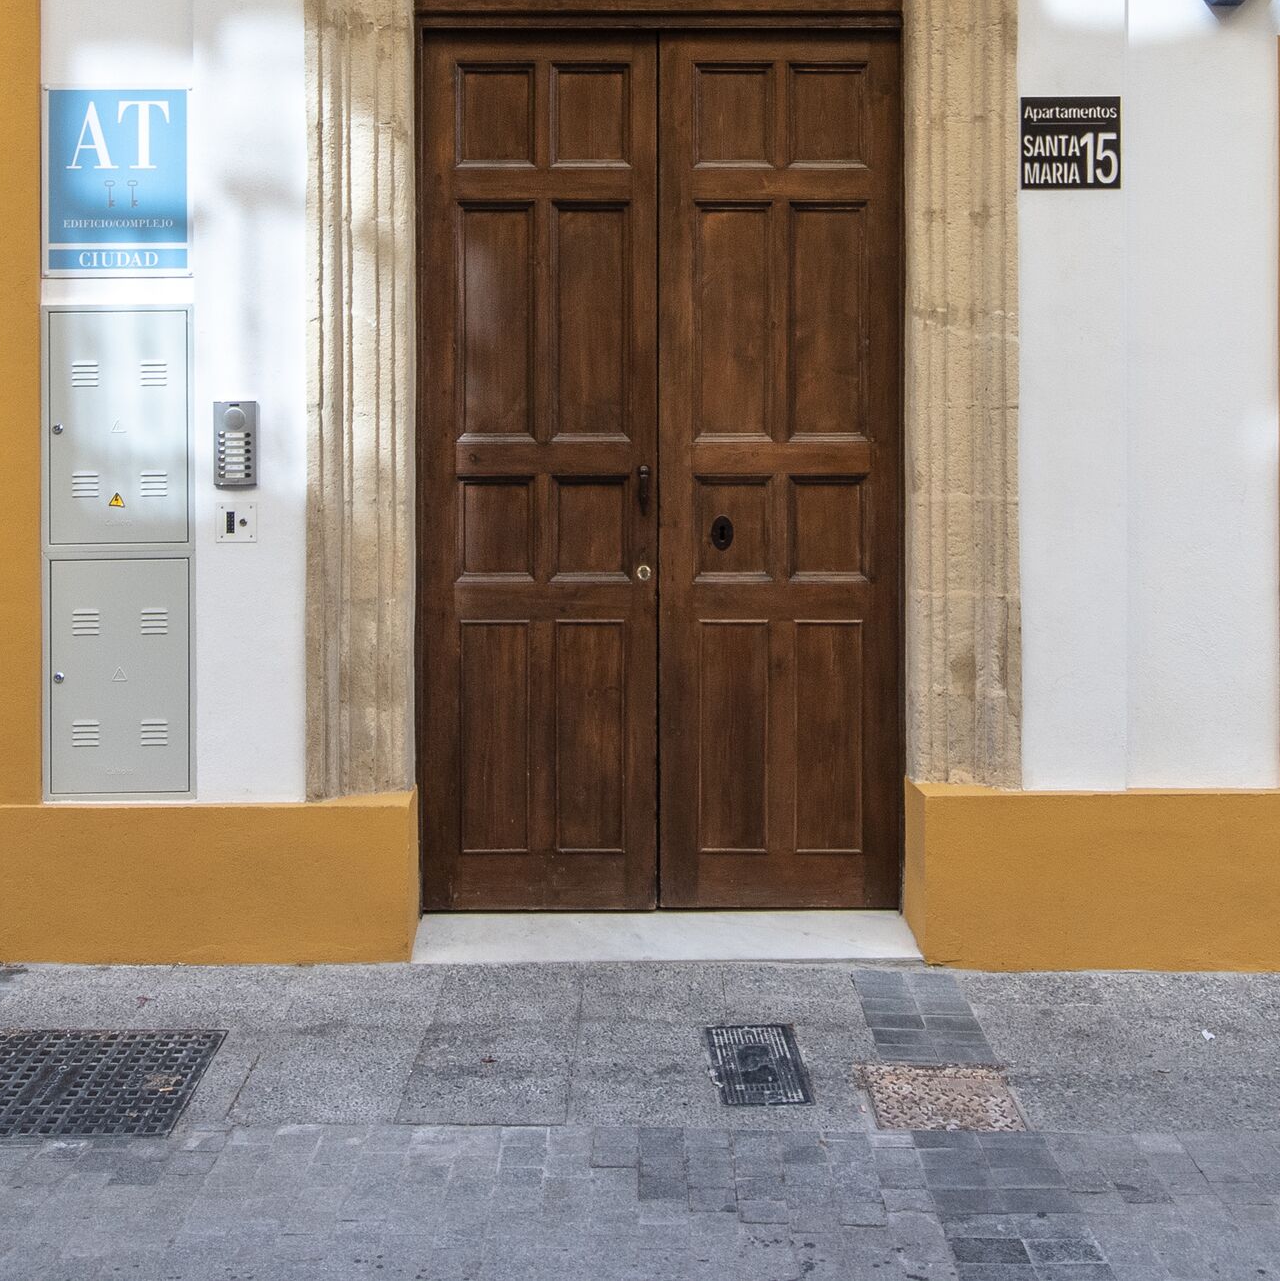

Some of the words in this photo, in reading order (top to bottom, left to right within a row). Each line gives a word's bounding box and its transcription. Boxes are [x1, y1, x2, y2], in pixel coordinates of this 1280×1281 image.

[1024, 106, 1117, 122] Apartamentos
[66, 100, 170, 170] AT
[1023, 135, 1080, 157] SANTA
[1080, 132, 1119, 184] 15
[1024, 162, 1080, 184] MARIA
[63, 218, 173, 229] EDIFICIO/COMPLEJO
[79, 251, 159, 268] CIUDAD
